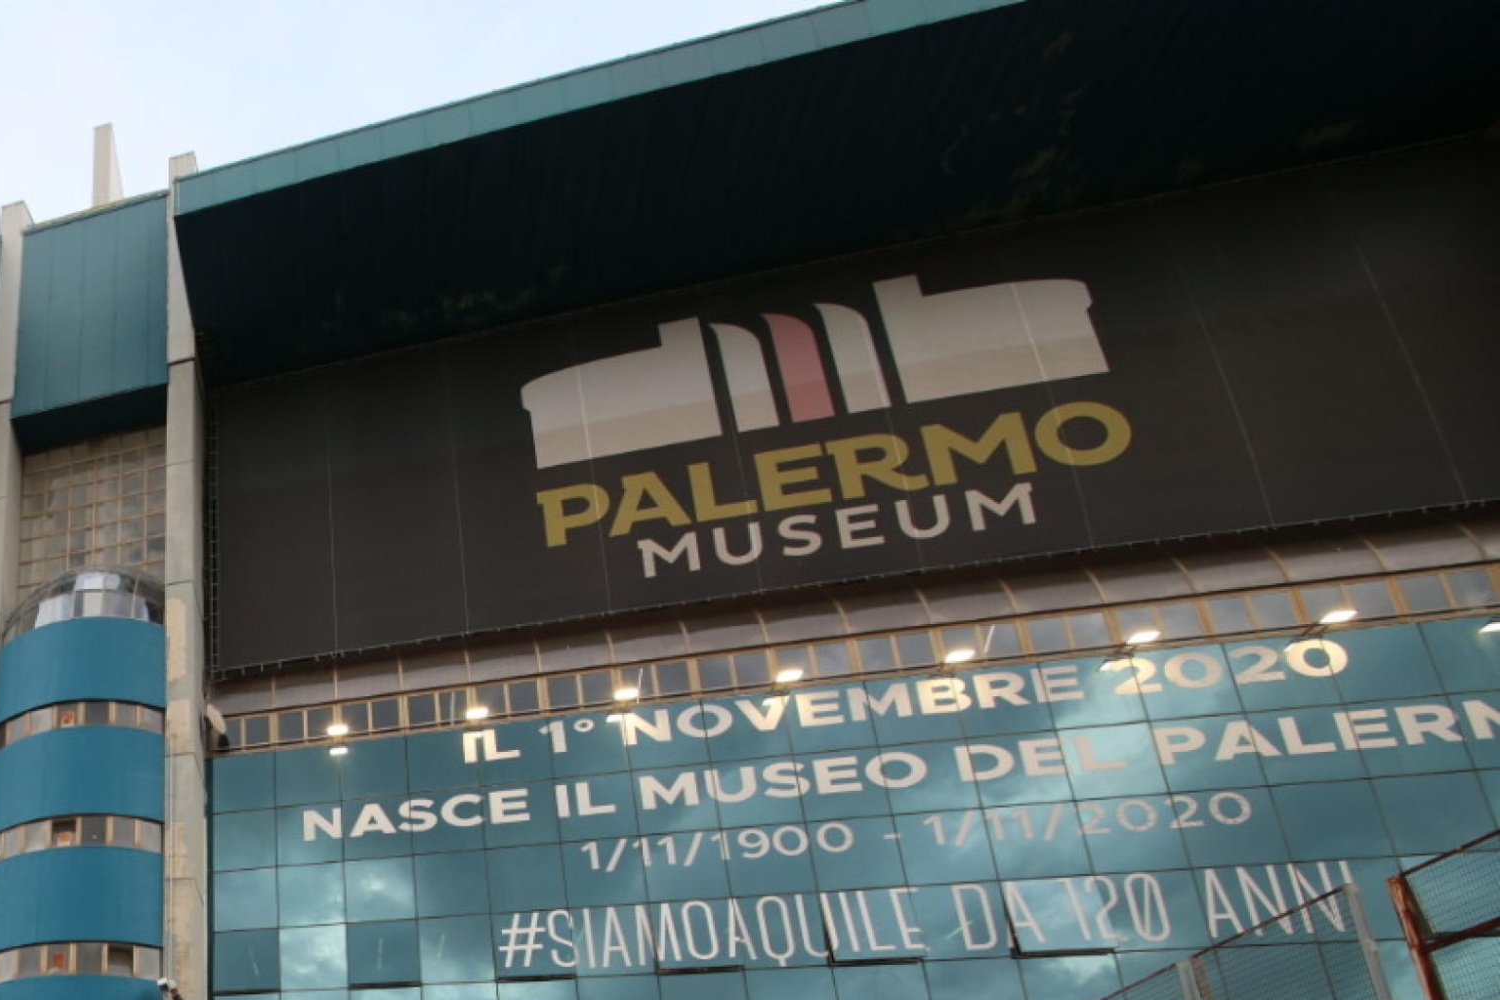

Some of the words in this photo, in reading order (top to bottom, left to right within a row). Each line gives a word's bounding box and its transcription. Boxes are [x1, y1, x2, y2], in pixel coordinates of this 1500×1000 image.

[537, 401, 1133, 548] PALERMO
[637, 482, 1038, 579] MUSEUM
[462, 728, 521, 764] IL
[538, 717, 596, 753] 1°
[621, 664, 1086, 746] NOVEMBRE
[1107, 638, 1349, 695] 2020
[303, 788, 531, 842] NASCE
[555, 781, 617, 819] IL
[638, 752, 928, 811] MUSEO
[953, 735, 1129, 783] DEL
[581, 821, 855, 873] 1/11/1900
[922, 791, 1252, 847] 1/11/2020
[499, 886, 930, 970] #SIAMOAQUILE
[951, 880, 1047, 951] DA
[1055, 871, 1172, 943] 120
